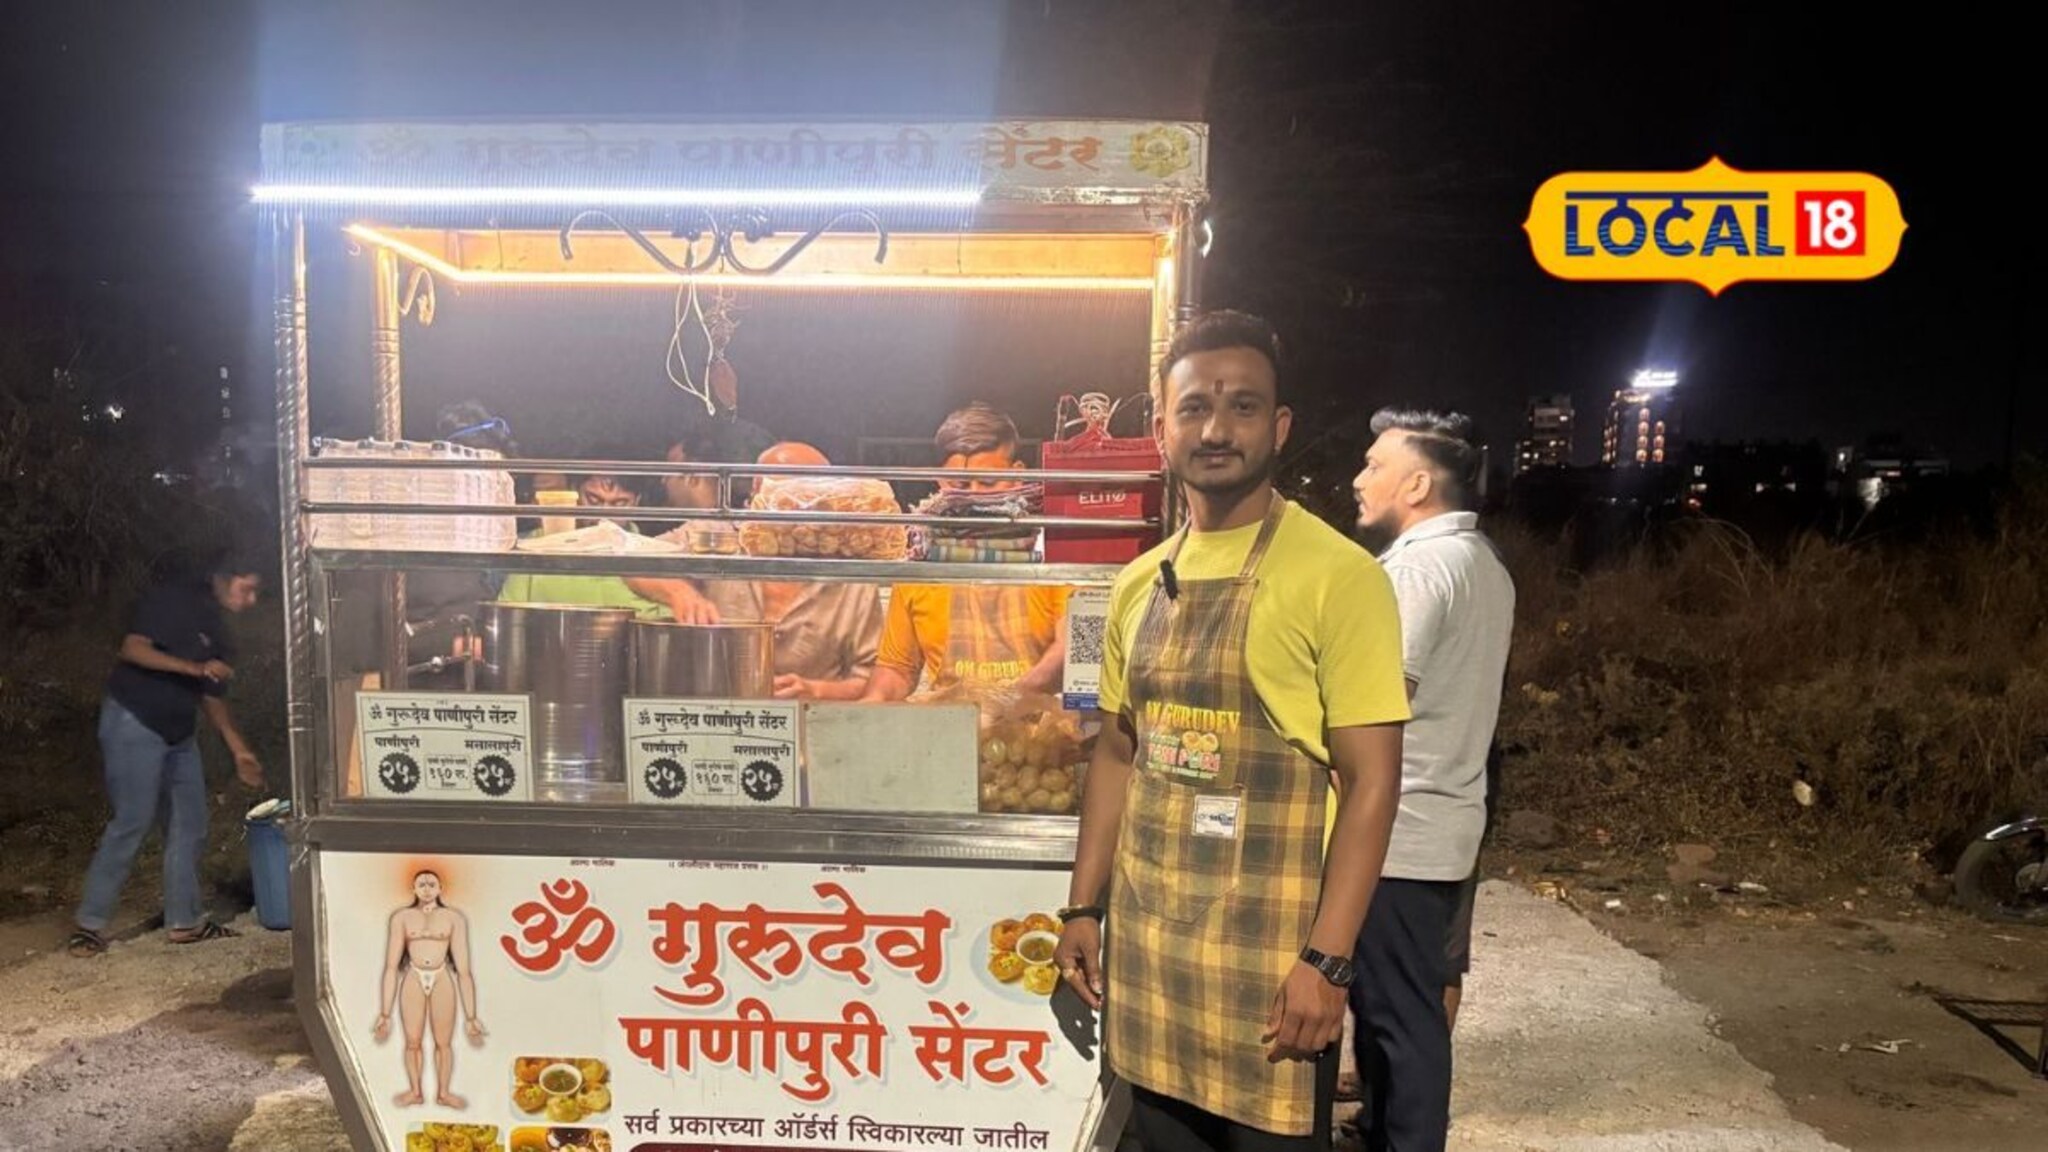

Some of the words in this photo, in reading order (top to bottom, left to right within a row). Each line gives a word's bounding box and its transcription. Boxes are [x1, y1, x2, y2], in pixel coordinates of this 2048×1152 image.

[433, 704, 486, 730] पाणीपुरी
[488, 704, 518, 724] सेंटर
[703, 710, 755, 735] पाणीपुरी
[759, 710, 788, 730] सेंटर
[374, 735, 421, 752] पाणीपुरी
[641, 740, 688, 757] पाणीपुरी
[500, 878, 615, 972] ॐ
[619, 998, 887, 1101] पाणीपुरी
[909, 1002, 1050, 1084] सेंटर
[622, 1109, 660, 1136] सर्व
[669, 1114, 764, 1139] प्रकारच्या
[774, 1112, 837, 1141] ऑर्डर्स
[848, 1115, 964, 1147] स्विकारल्या
[973, 1122, 1050, 1150] जातील
